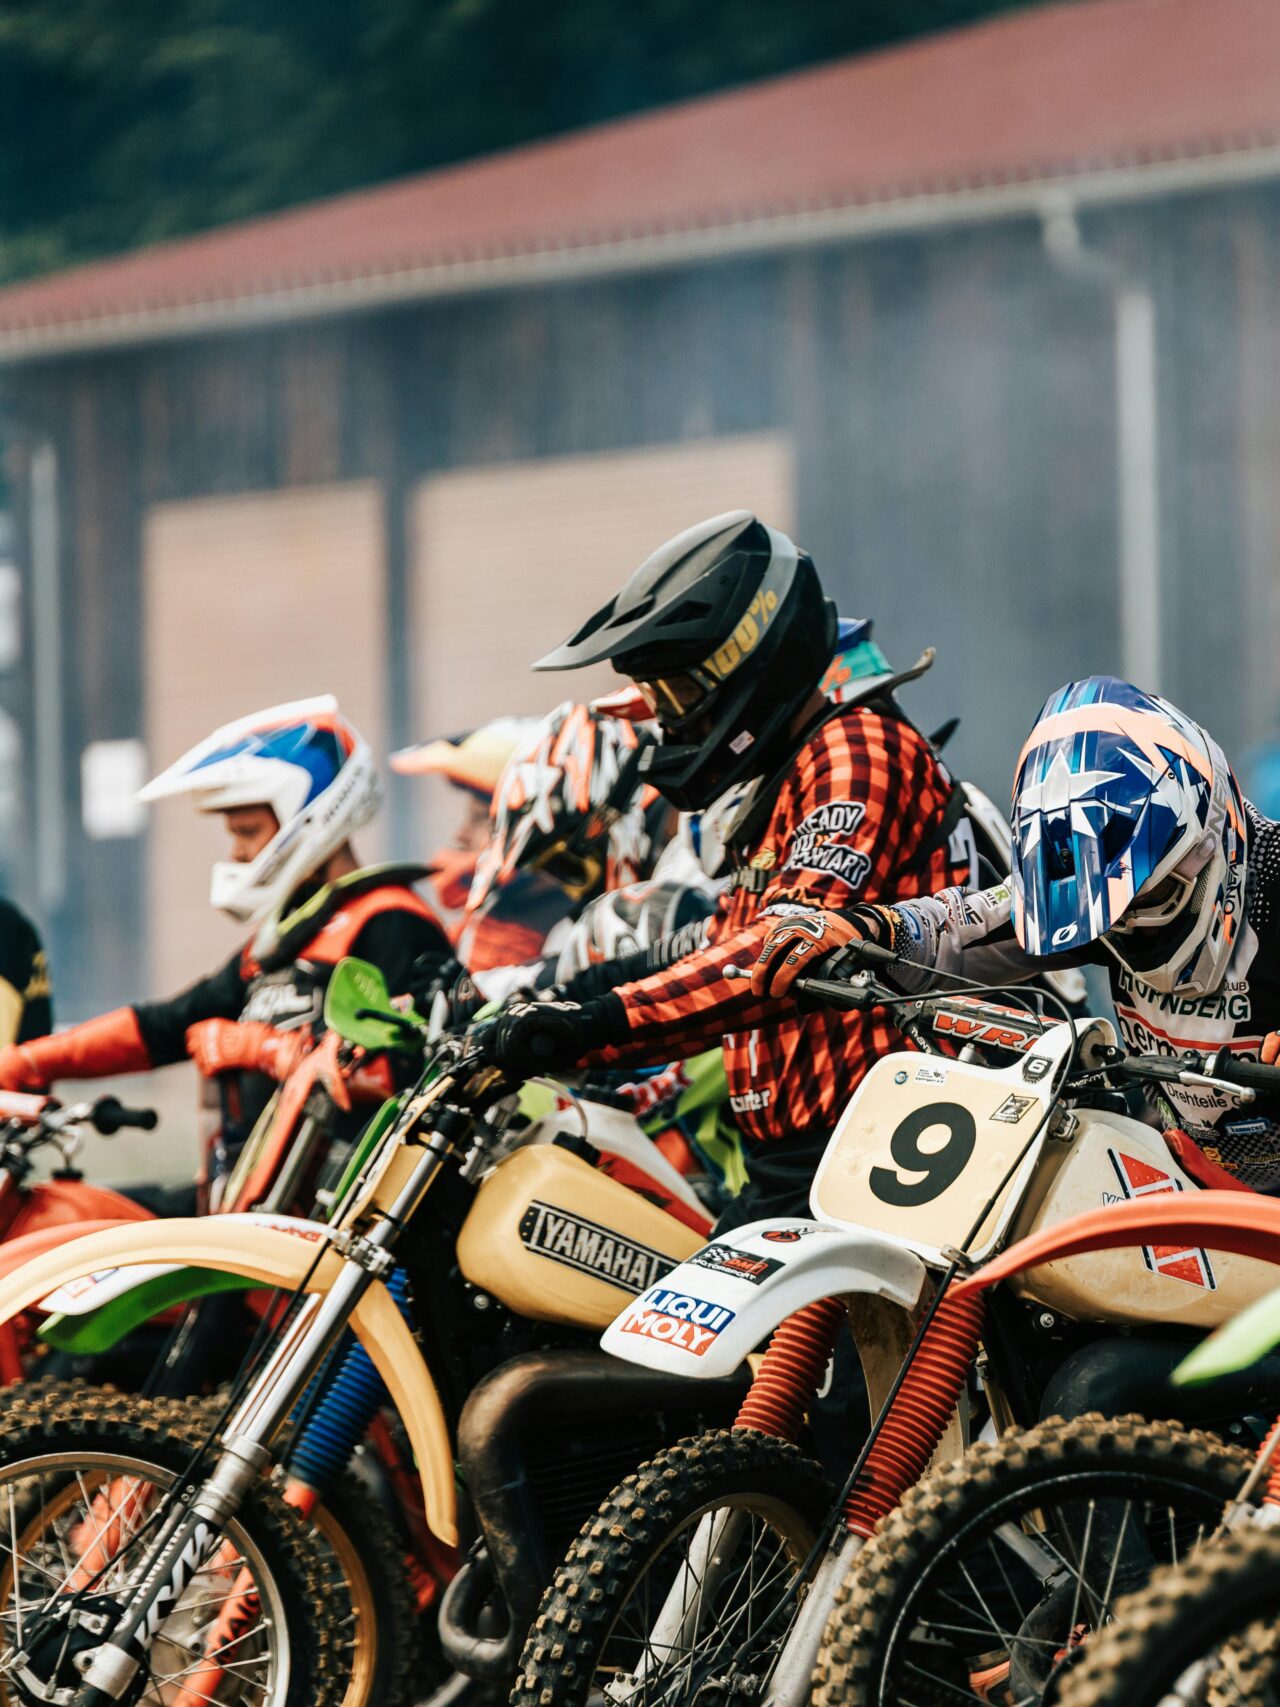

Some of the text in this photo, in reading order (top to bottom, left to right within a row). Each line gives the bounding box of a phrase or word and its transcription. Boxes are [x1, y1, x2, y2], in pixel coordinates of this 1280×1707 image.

[696, 590, 778, 689] 100%
[1028, 1059, 1048, 1073] 6
[1167, 1083, 1228, 1108] Drehteile
[869, 1102, 976, 1207] 9
[543, 1213, 648, 1288] YAMAHA
[691, 1257, 757, 1281] MOTORSPORT
[650, 1290, 731, 1331] LIQUI
[625, 1311, 716, 1351] MOLY
